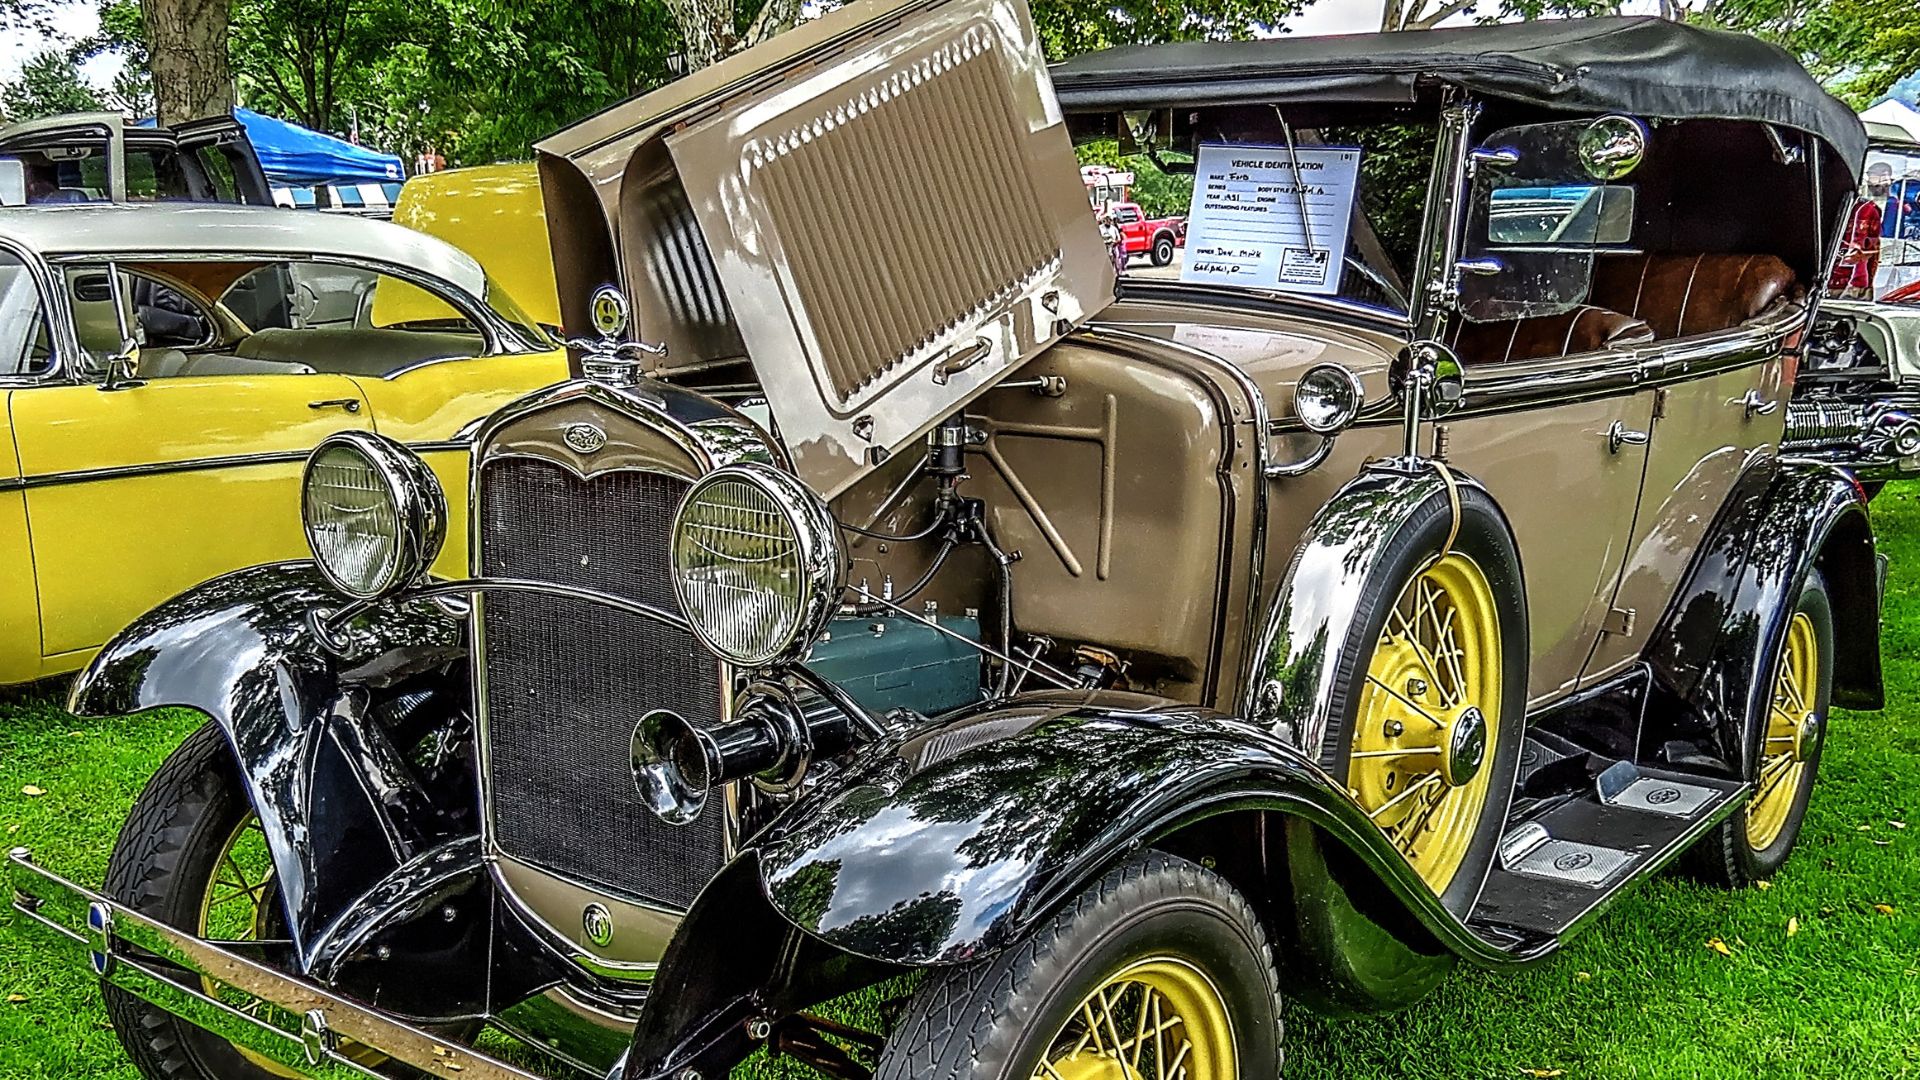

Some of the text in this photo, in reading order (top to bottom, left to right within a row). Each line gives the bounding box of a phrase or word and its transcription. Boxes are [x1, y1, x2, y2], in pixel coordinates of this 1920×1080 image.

[1231, 160, 1324, 170] VEHICLE IDENTIFCATION
[1204, 203, 1239, 211] OUTSTANDING
